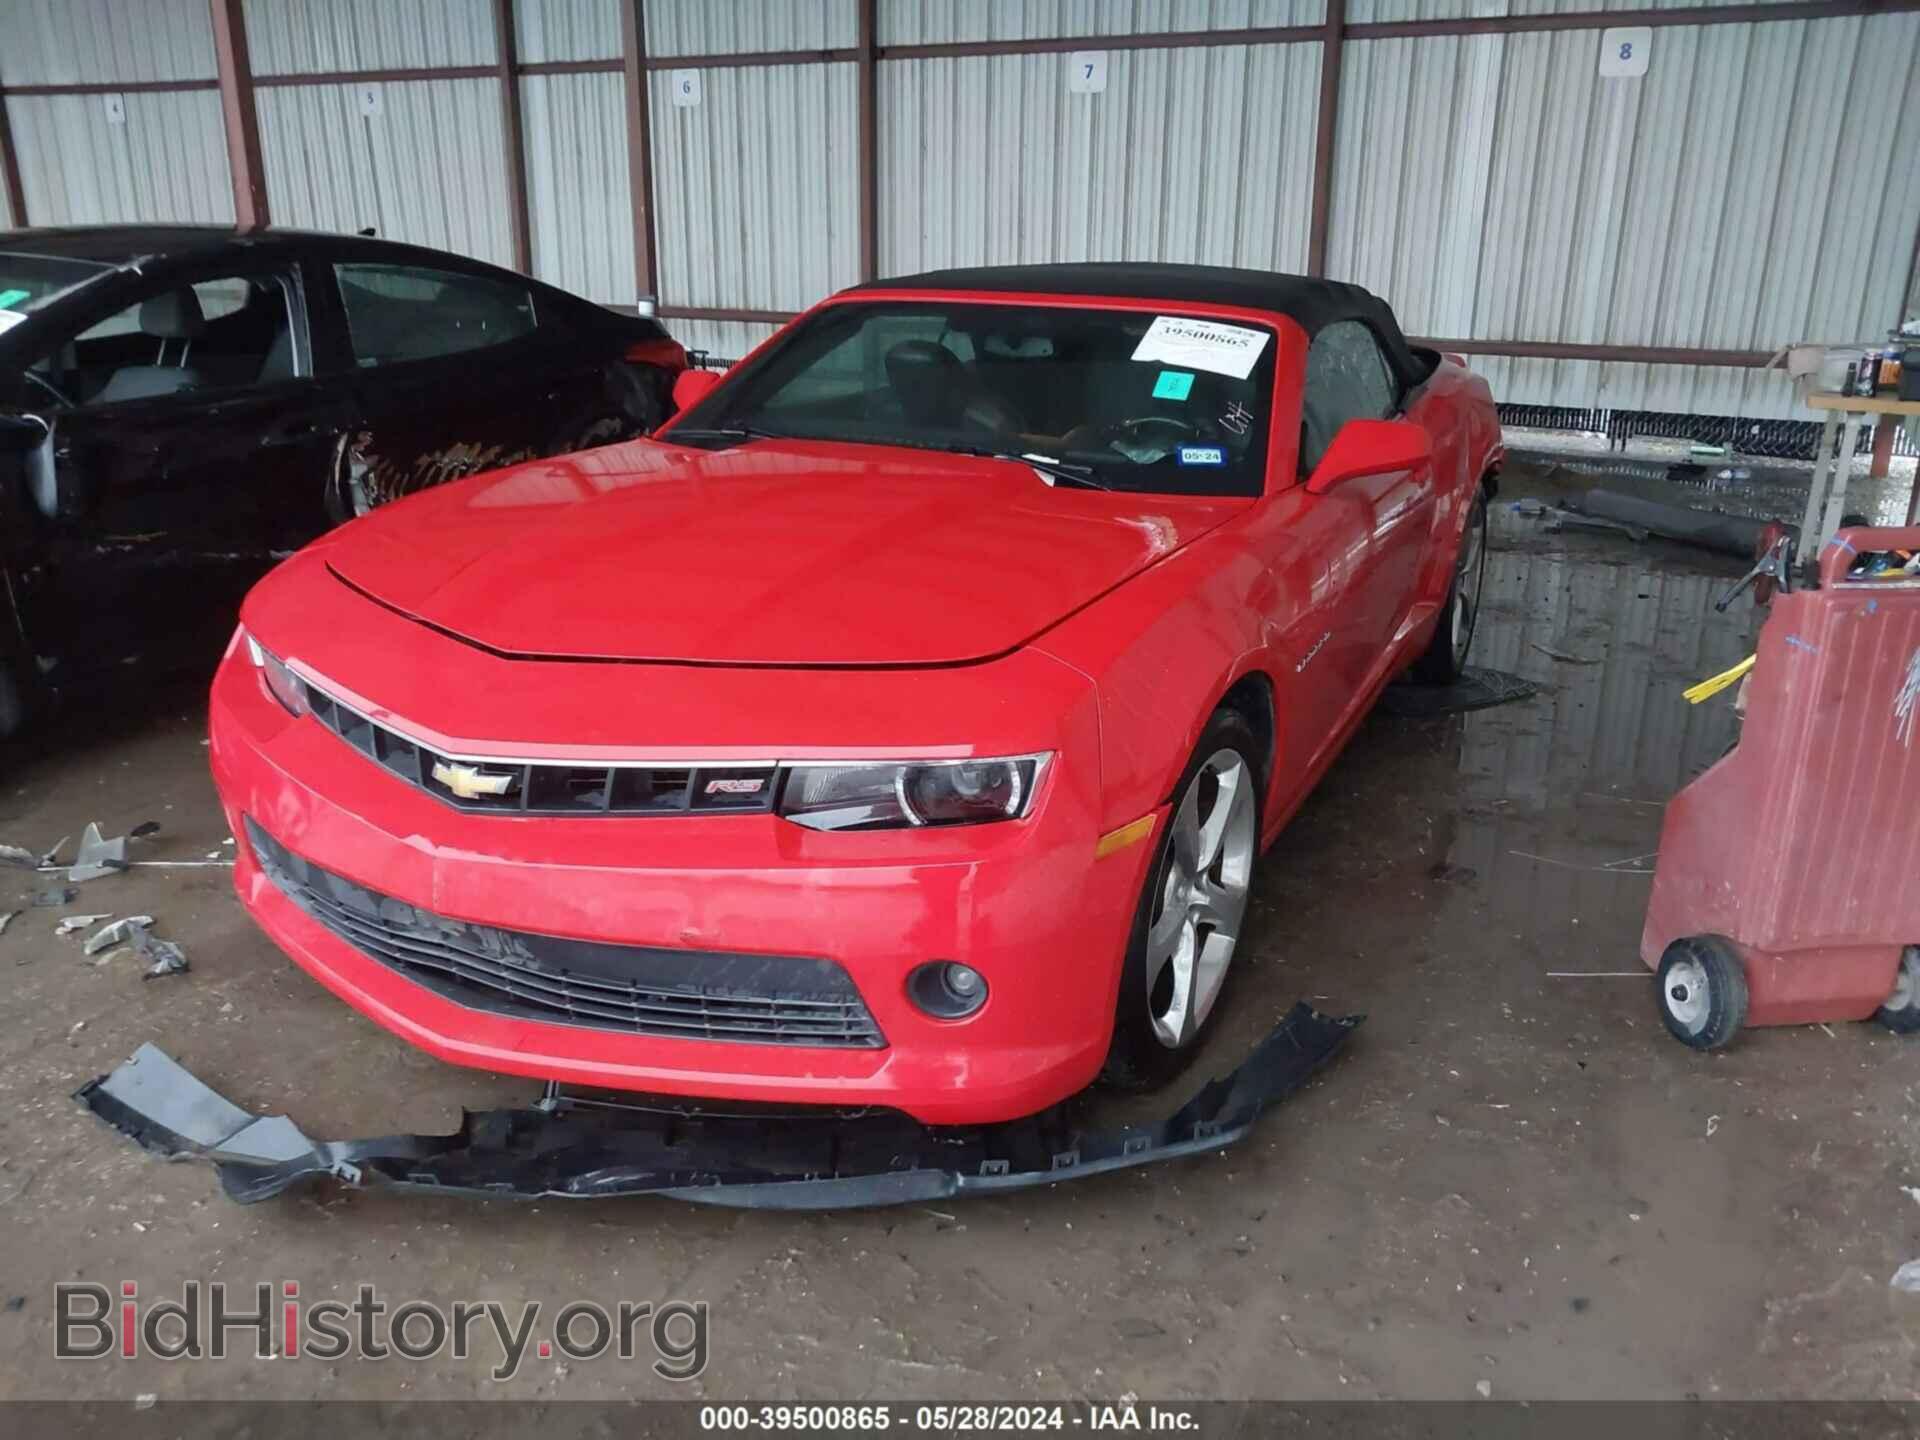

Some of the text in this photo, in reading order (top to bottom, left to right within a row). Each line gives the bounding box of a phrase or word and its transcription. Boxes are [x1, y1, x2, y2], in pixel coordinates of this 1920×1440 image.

[1619, 42, 1632, 60] 8
[1084, 63, 1094, 79] 7
[683, 80, 690, 94] 6
[1184, 452, 1219, 460] 05-24
[704, 779, 764, 794] RS
